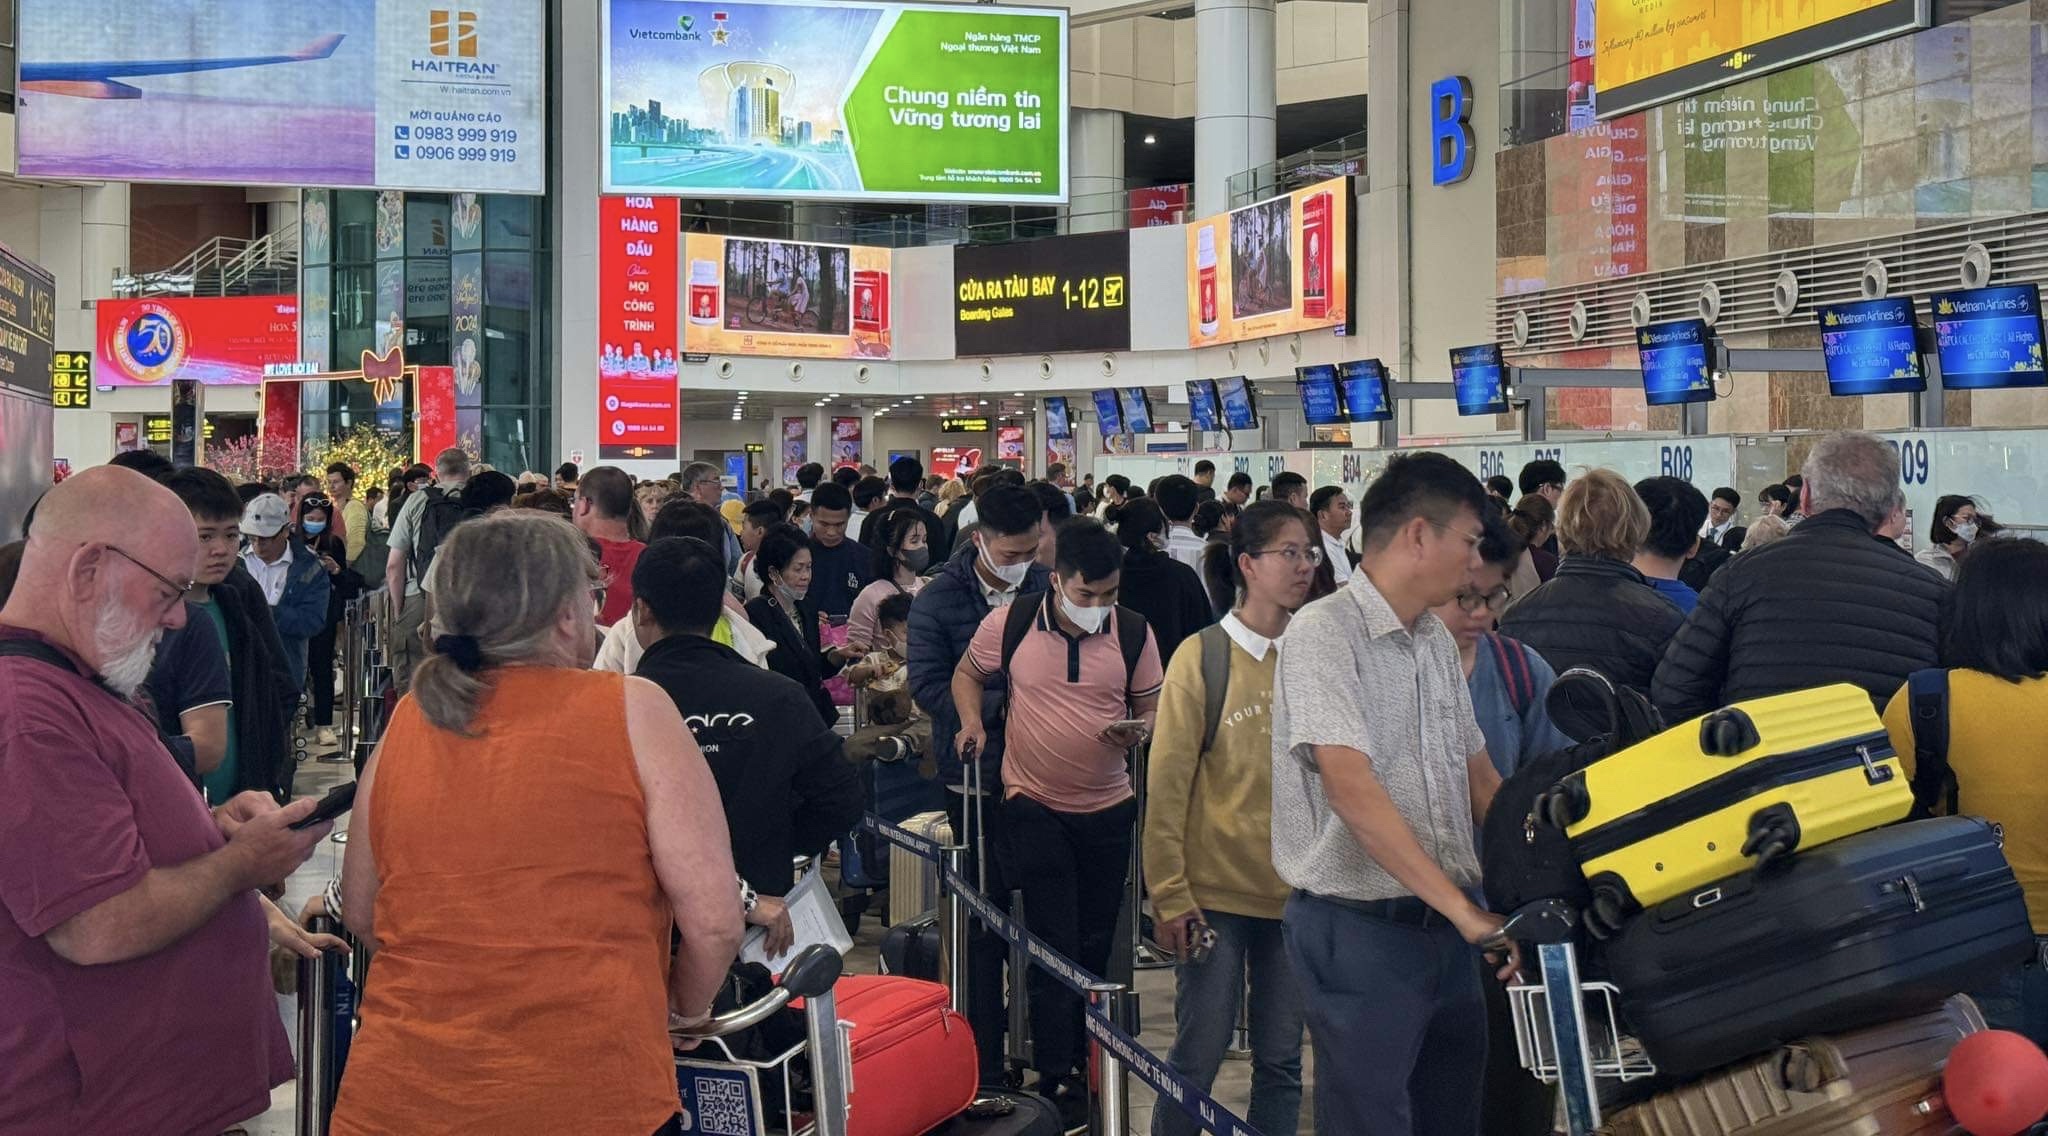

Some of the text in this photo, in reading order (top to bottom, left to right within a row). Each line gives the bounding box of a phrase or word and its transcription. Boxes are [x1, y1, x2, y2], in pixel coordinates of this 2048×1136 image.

[630, 28, 701, 41] Vietcombank
[990, 32, 1011, 43] hàng
[1013, 33, 1041, 43] TMCP
[1001, 44, 1018, 54] Việt
[1021, 45, 1041, 54] Nam
[412, 59, 495, 74] HAITRAN
[884, 85, 1041, 109] Chung niềm tin
[410, 111, 432, 120] MỜI
[477, 111, 502, 123] CÁO
[889, 107, 1041, 132] Vững tương lai
[415, 126, 517, 143] 0983 999 919
[1431, 76, 1474, 187] B
[416, 146, 516, 163] 0906 999 919
[621, 216, 659, 234] HÀNG
[628, 281, 650, 295] MỌI
[960, 273, 1100, 310] CỬA RA TÀU BAY 1-12
[623, 298, 655, 312] CÔNG
[960, 307, 1014, 322] Boarding Gates
[623, 318, 655, 332] TRÌNH
[1342, 455, 1361, 483] B04
[1480, 450, 1505, 483] B06
[1661, 446, 1693, 483] B08
[1886, 439, 1929, 485] 09
[1224, 704, 1262, 727] YOUR
